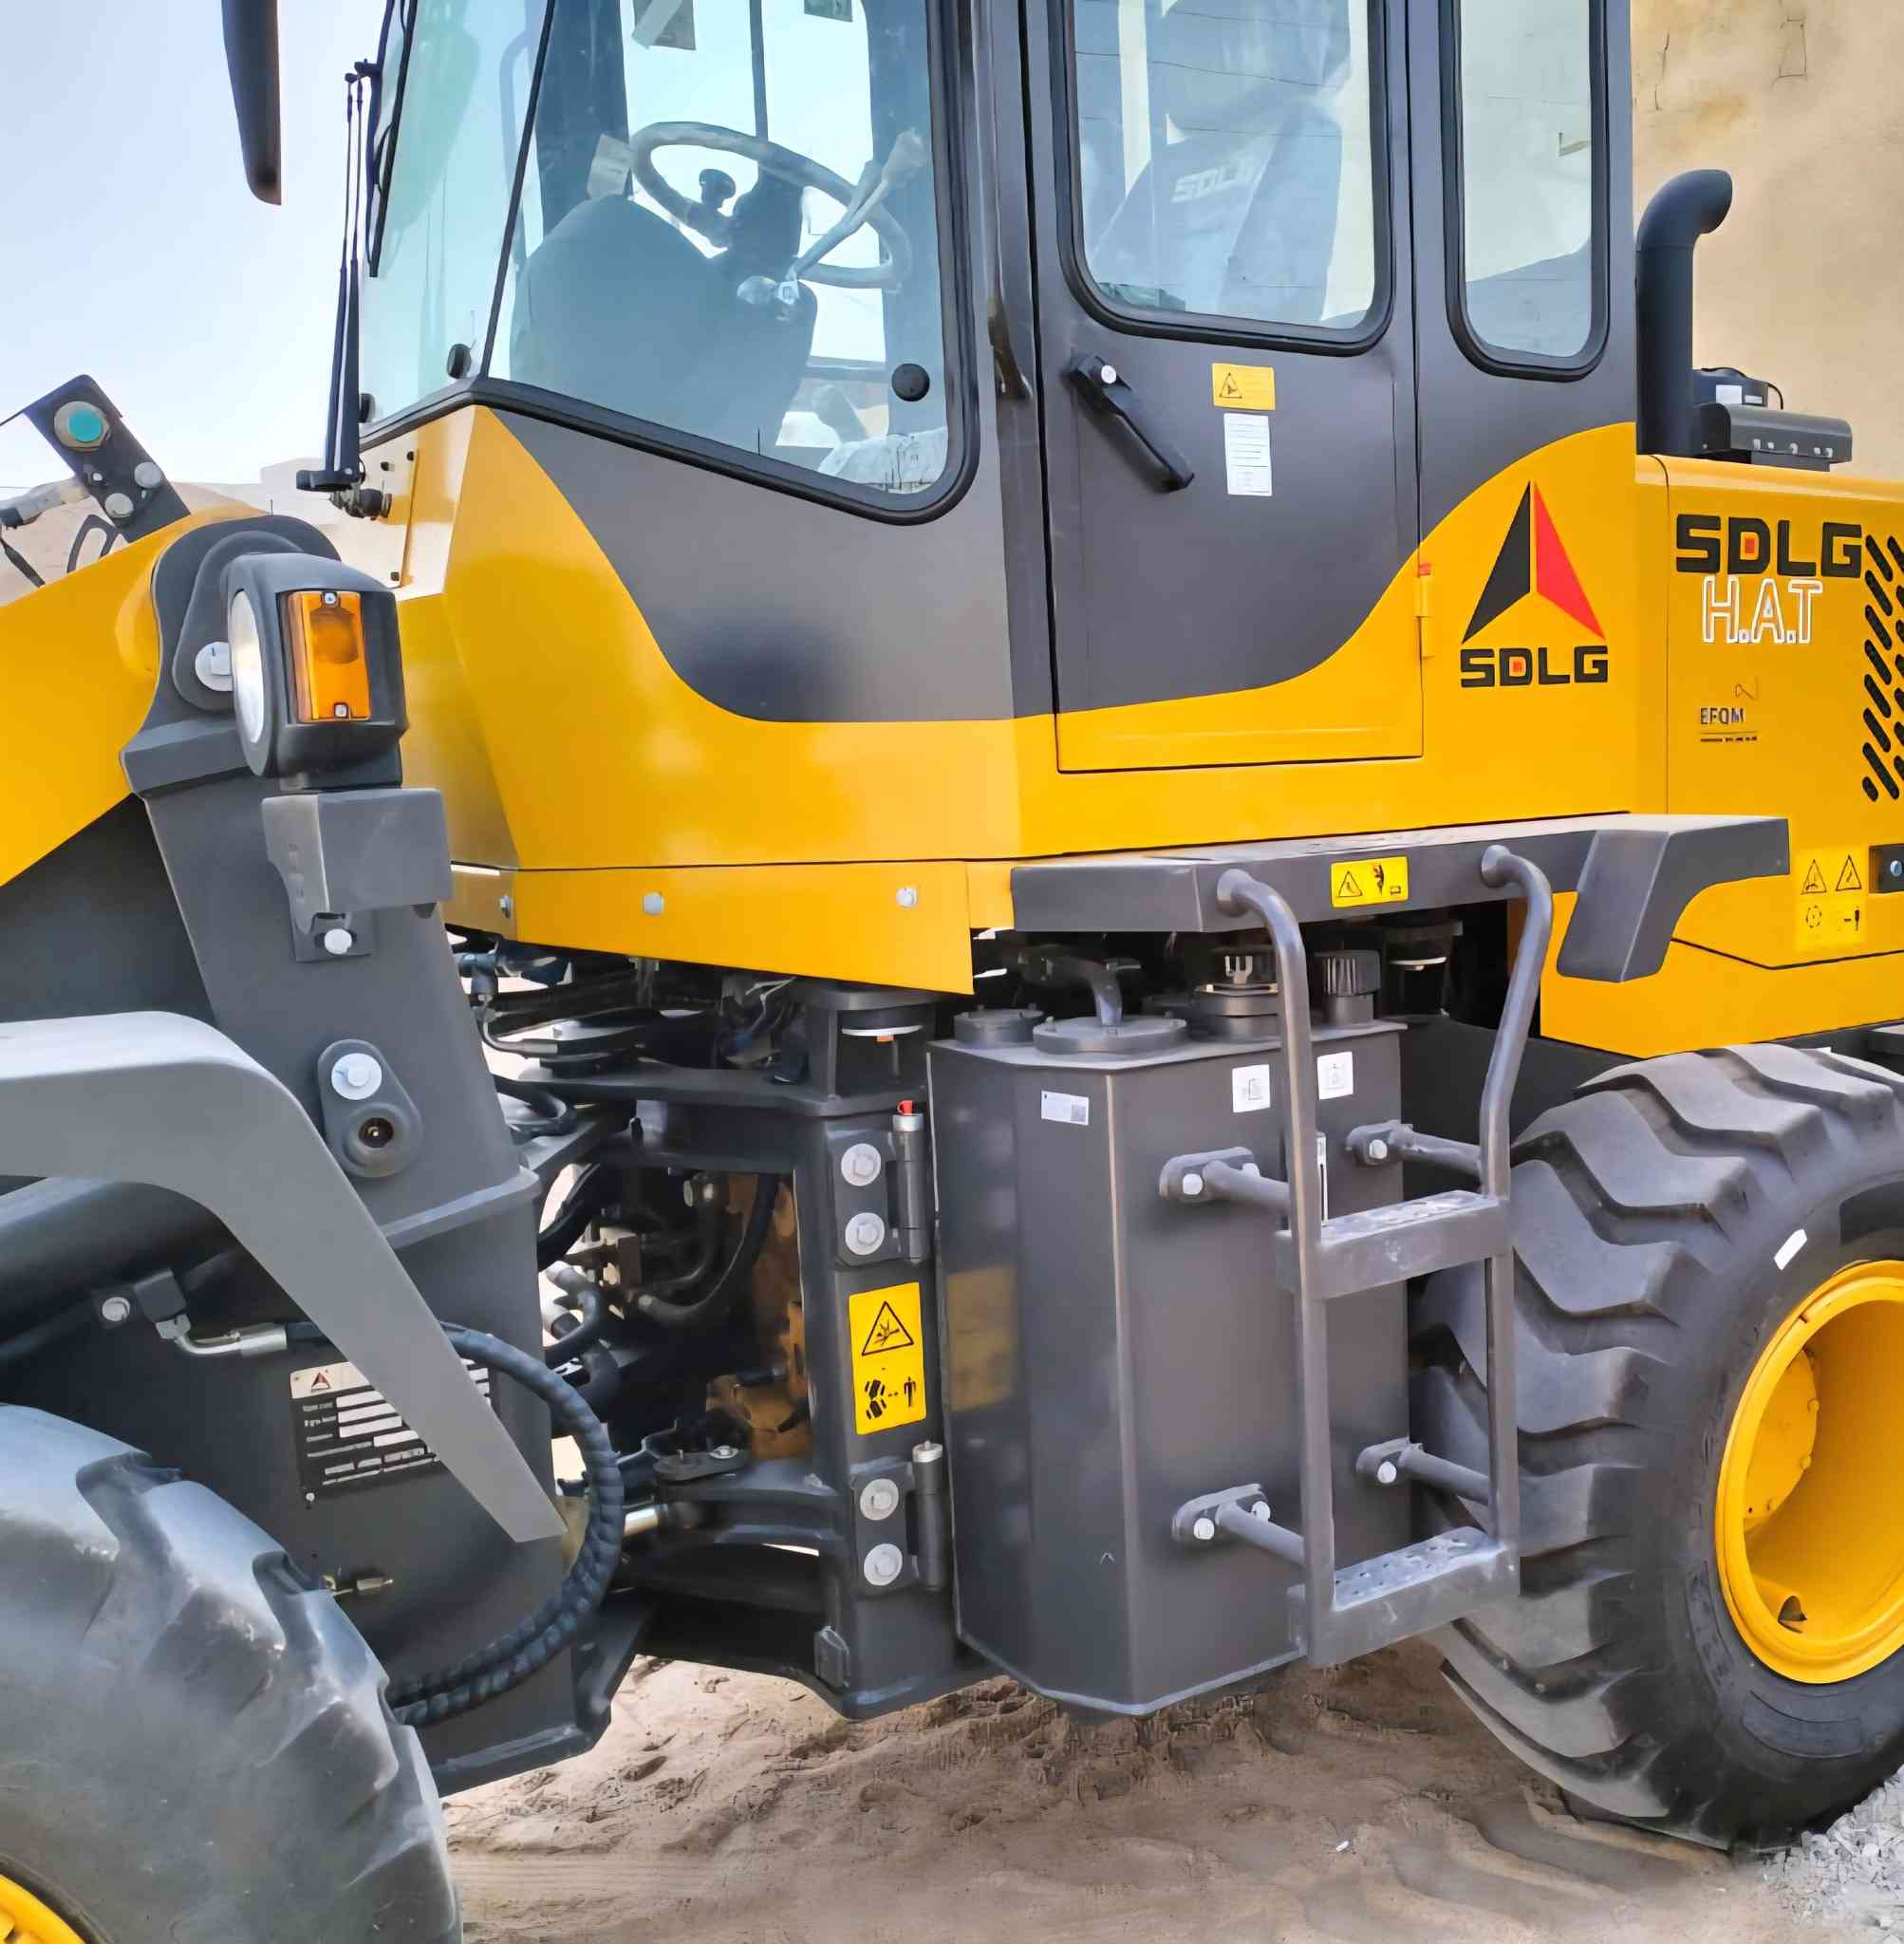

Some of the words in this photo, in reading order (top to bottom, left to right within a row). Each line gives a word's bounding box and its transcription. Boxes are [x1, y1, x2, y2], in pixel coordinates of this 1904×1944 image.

[1676, 514, 1862, 578] SDLG
[1702, 575, 1822, 644] H.A.T
[1460, 645, 1608, 688] SDLG
